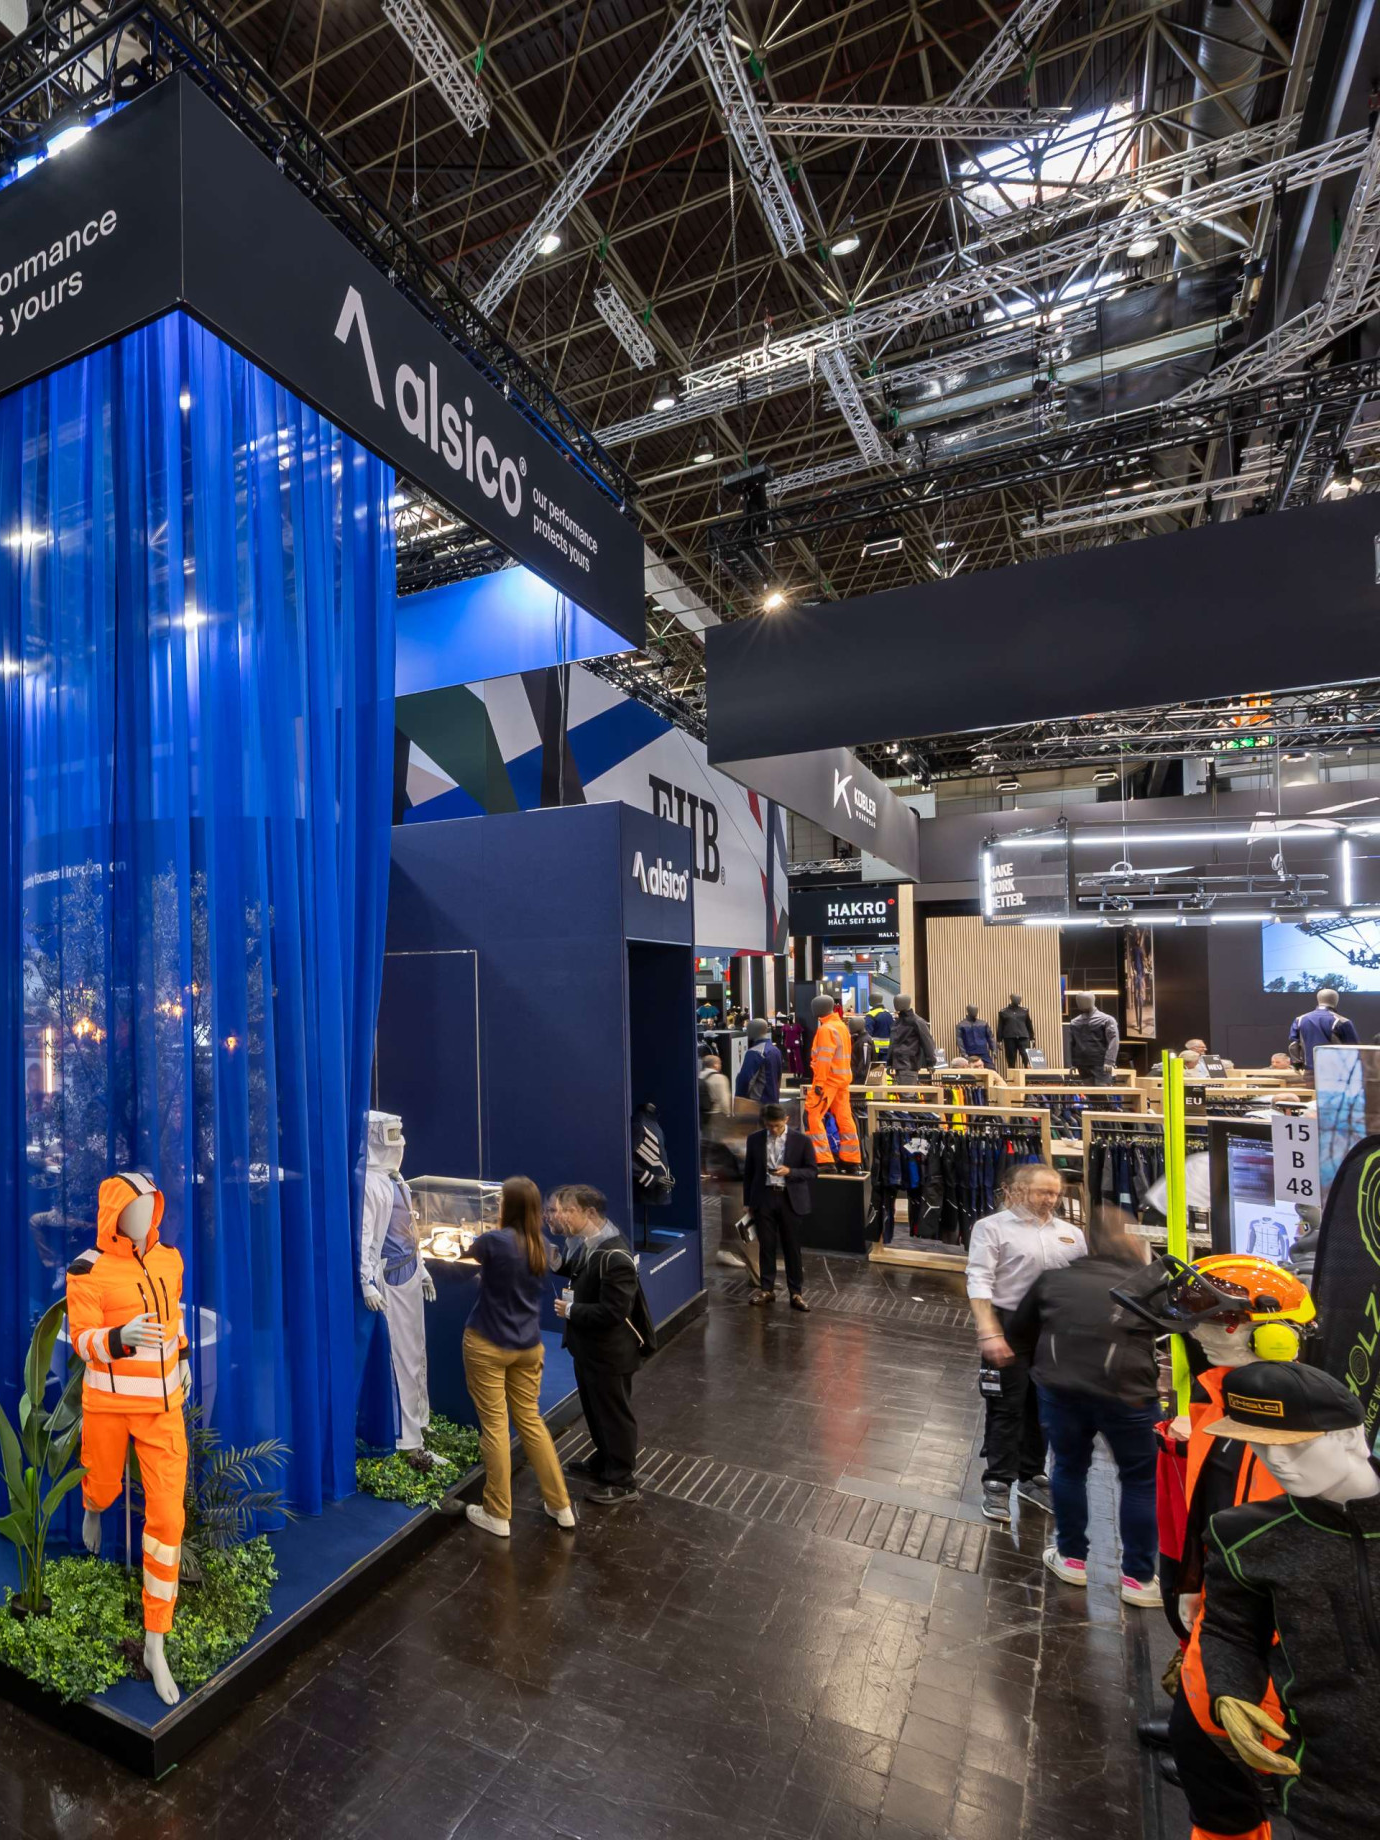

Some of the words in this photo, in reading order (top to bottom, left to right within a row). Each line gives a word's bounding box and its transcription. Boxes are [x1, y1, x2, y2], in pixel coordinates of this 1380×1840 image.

[10, 269, 84, 337] yours
[532, 487, 548, 511] our
[549, 500, 598, 554] performance
[533, 513, 568, 555] protects
[569, 543, 590, 573] yours
[827, 901, 887, 917] HAKRO
[849, 917, 865, 925] SEIT
[869, 1070, 883, 1079] NEU
[1185, 1097, 1202, 1106] EU
[1285, 1123, 1310, 1142] 15
[1292, 1151, 1305, 1169] B
[1286, 1178, 1313, 1197] 48
